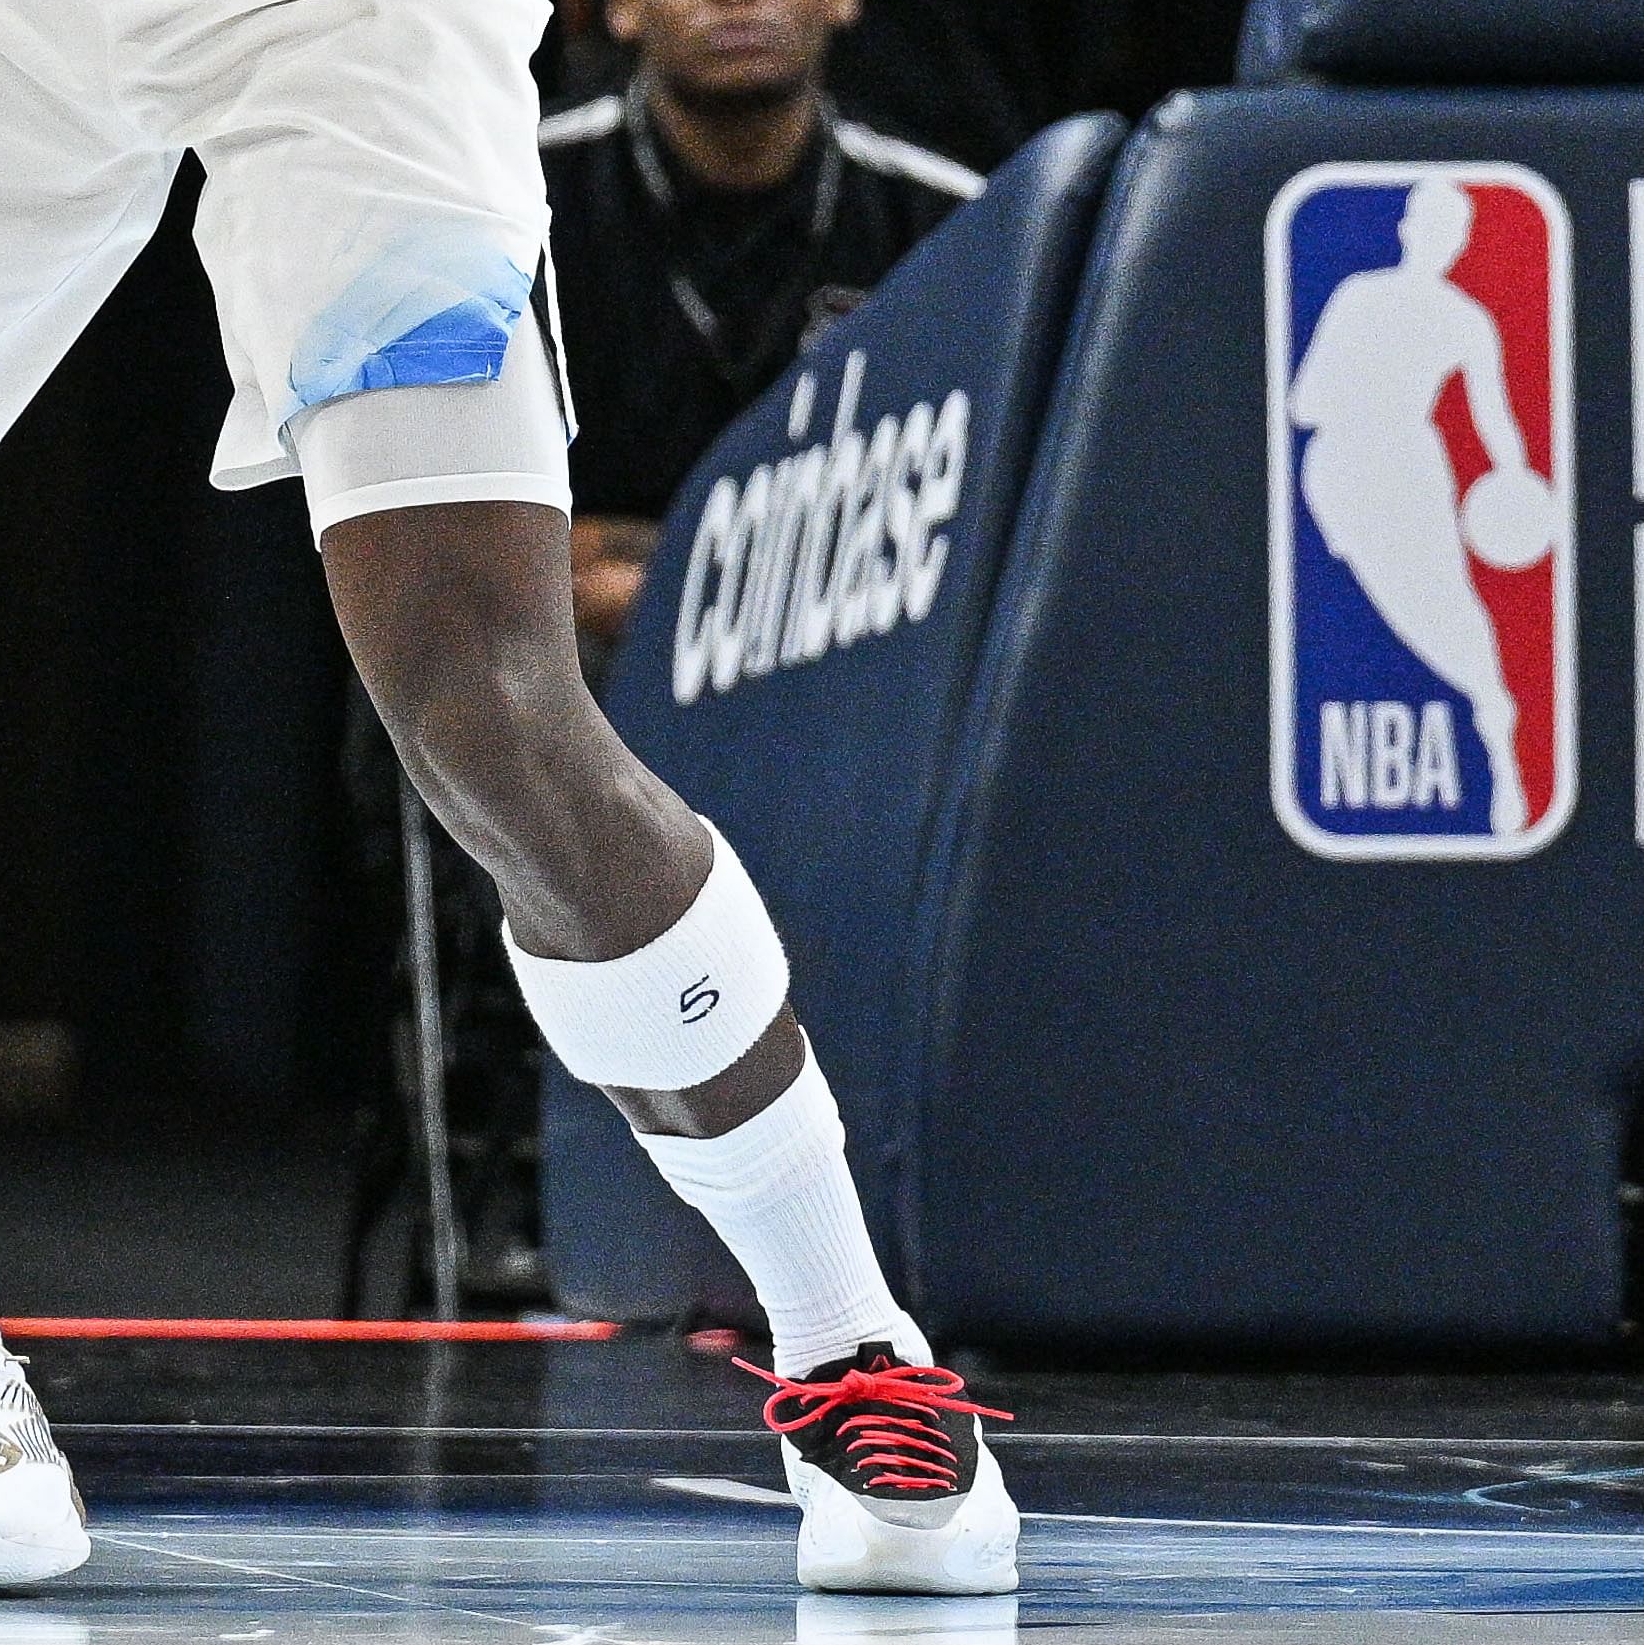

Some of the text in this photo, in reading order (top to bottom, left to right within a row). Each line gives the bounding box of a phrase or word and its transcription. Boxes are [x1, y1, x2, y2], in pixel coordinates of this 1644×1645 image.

[671, 352, 973, 706] coinbase
[1318, 698, 1461, 812] NBA
[679, 974, 720, 1025] 5
